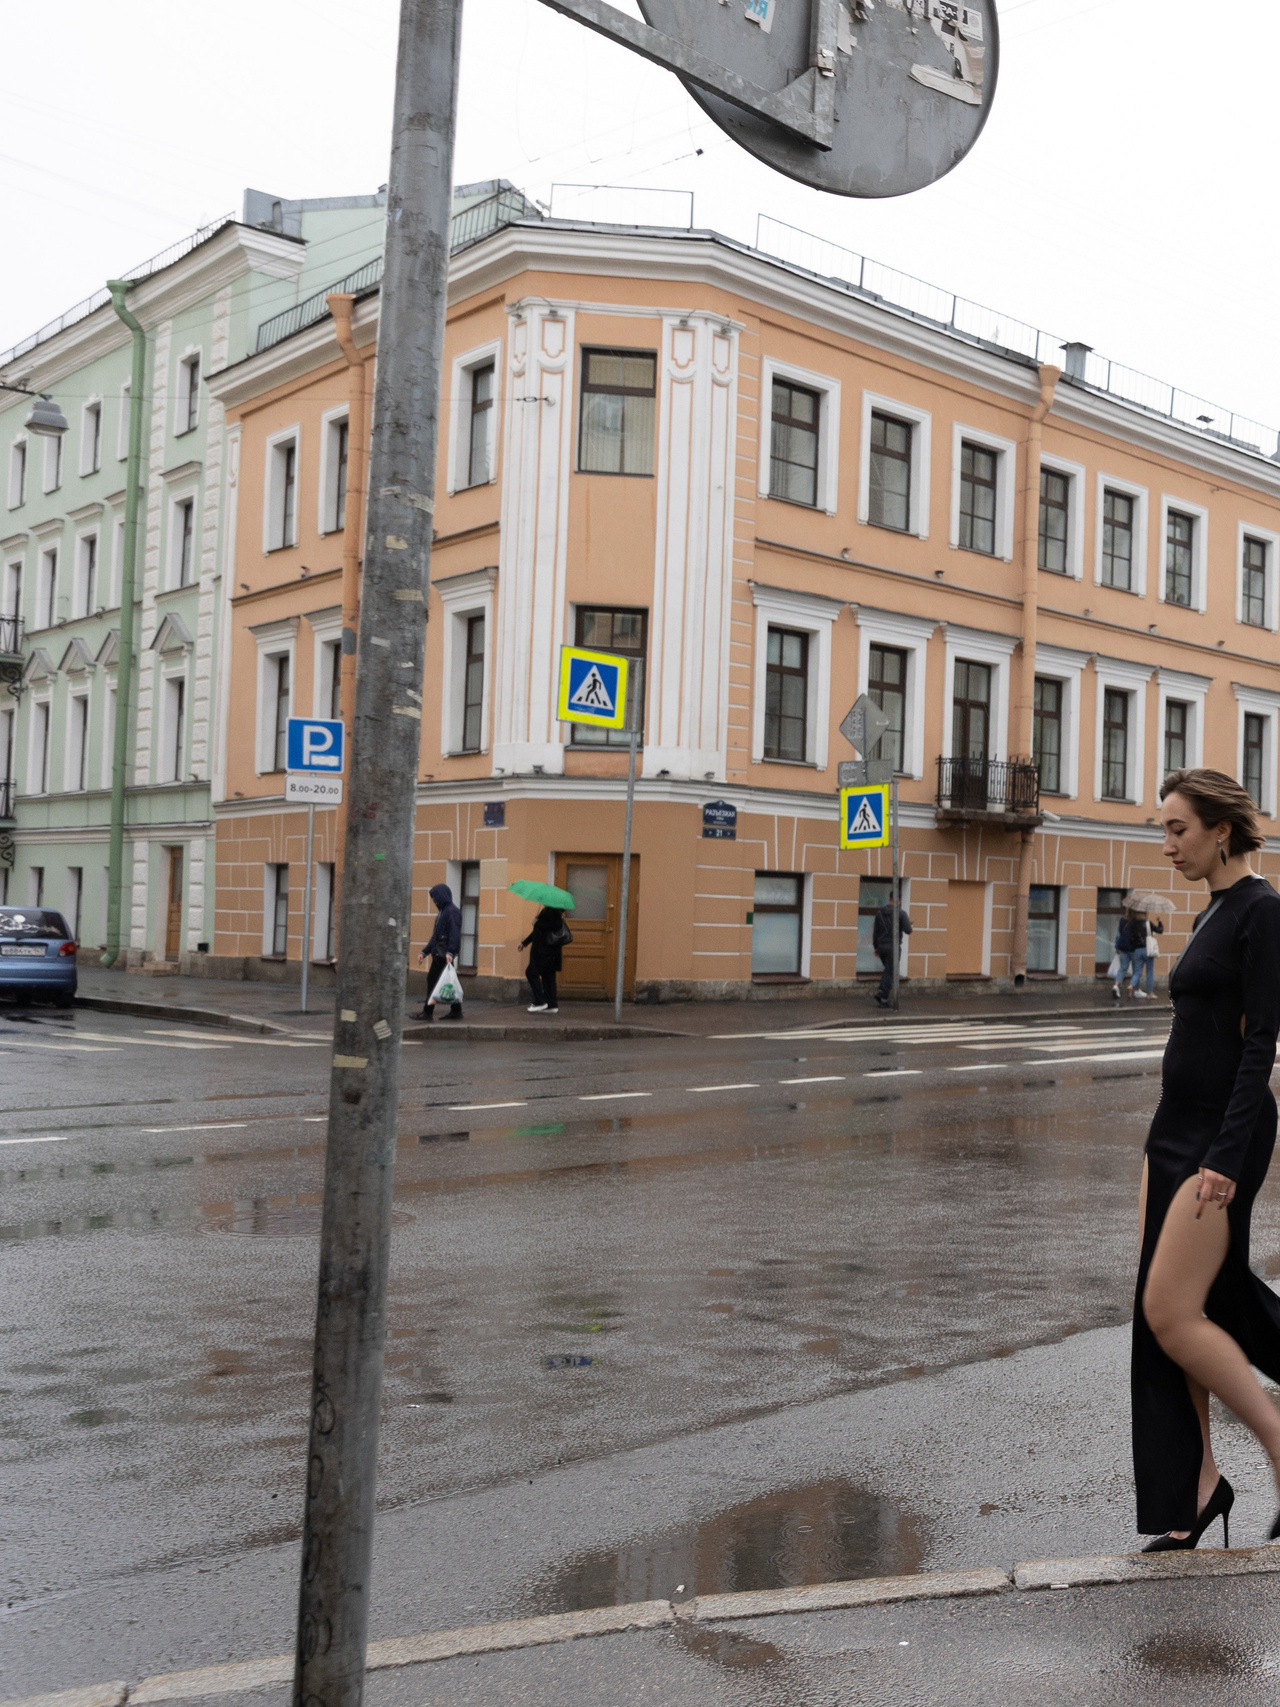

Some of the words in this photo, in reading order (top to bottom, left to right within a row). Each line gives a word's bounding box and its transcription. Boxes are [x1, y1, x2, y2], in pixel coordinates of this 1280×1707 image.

[303, 725, 333, 765] P
[290, 783, 339, 795] 8.00-20.00
[716, 829, 723, 837] 21
